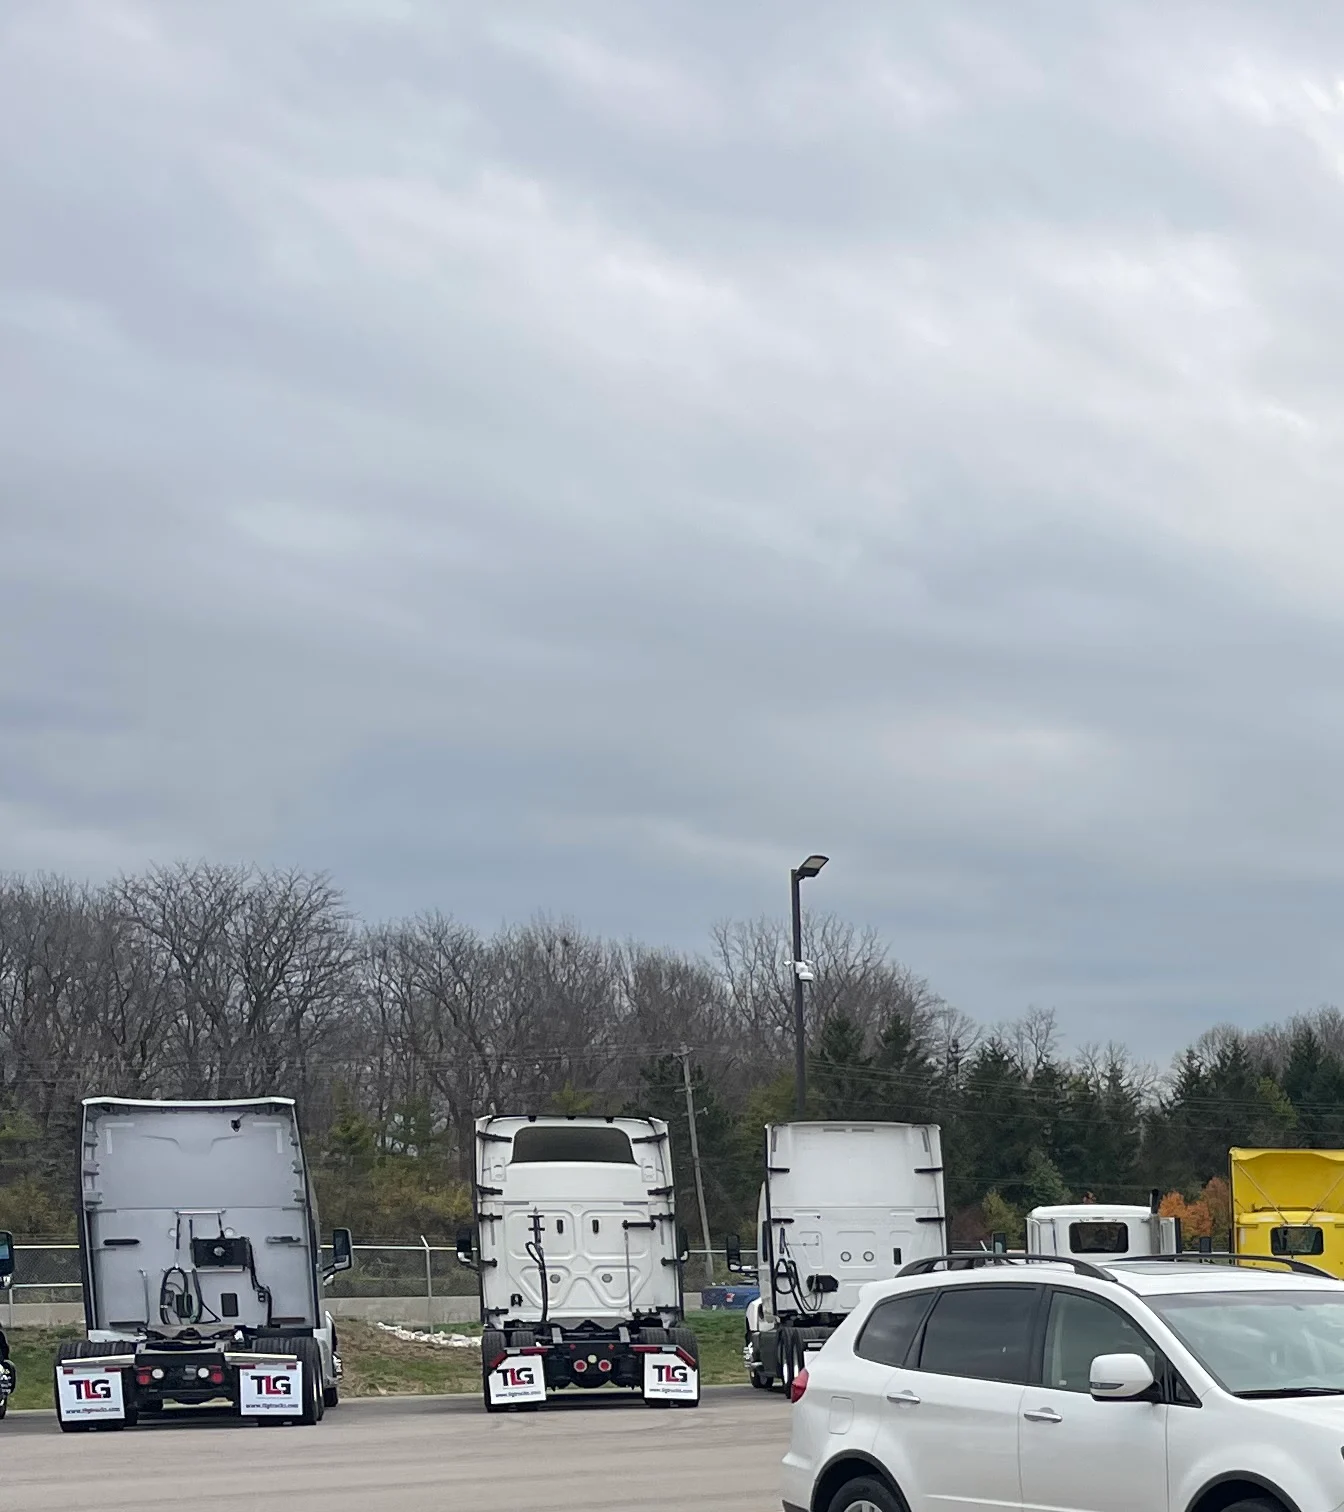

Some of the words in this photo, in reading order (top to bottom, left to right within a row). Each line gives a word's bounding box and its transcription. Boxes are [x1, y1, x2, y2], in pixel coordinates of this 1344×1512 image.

[496, 1367, 534, 1386] TLG
[652, 1365, 688, 1382] TLG
[68, 1379, 112, 1400] TLG
[250, 1375, 292, 1395] TLG
